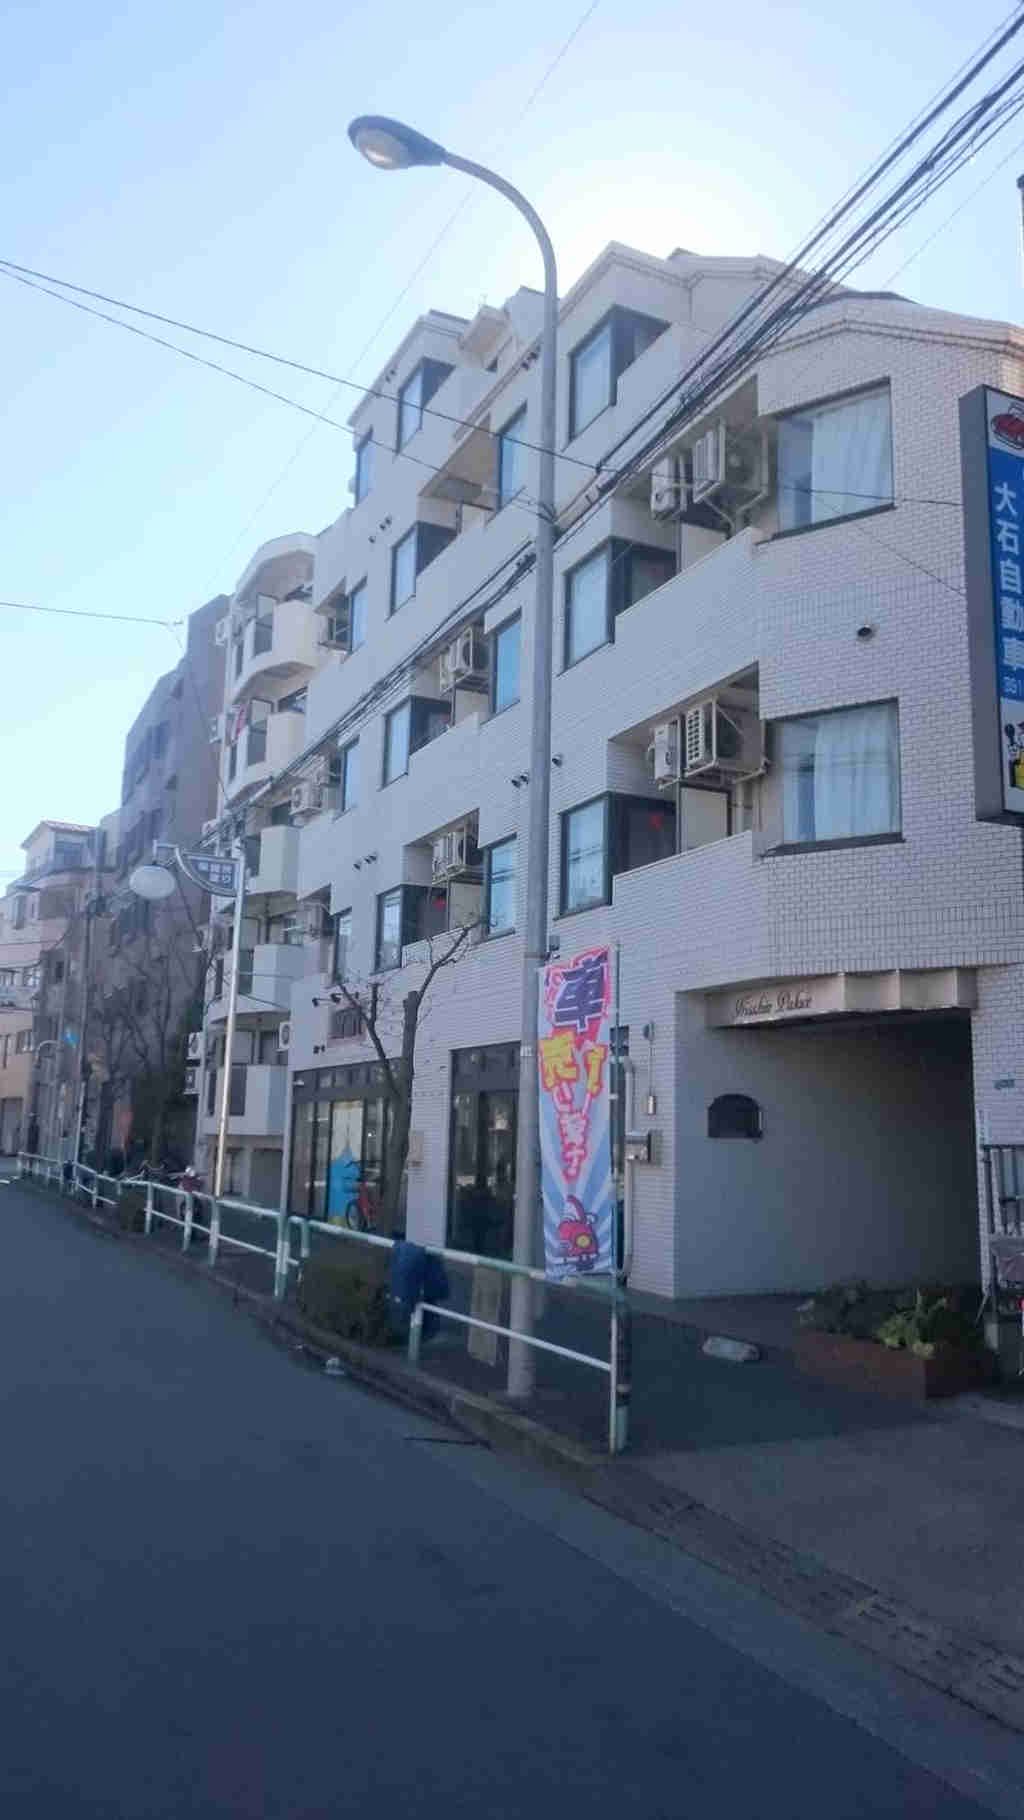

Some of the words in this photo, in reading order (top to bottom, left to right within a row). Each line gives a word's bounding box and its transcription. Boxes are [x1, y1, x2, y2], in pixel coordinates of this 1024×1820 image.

[993, 481, 1024, 671] 大石自動車
